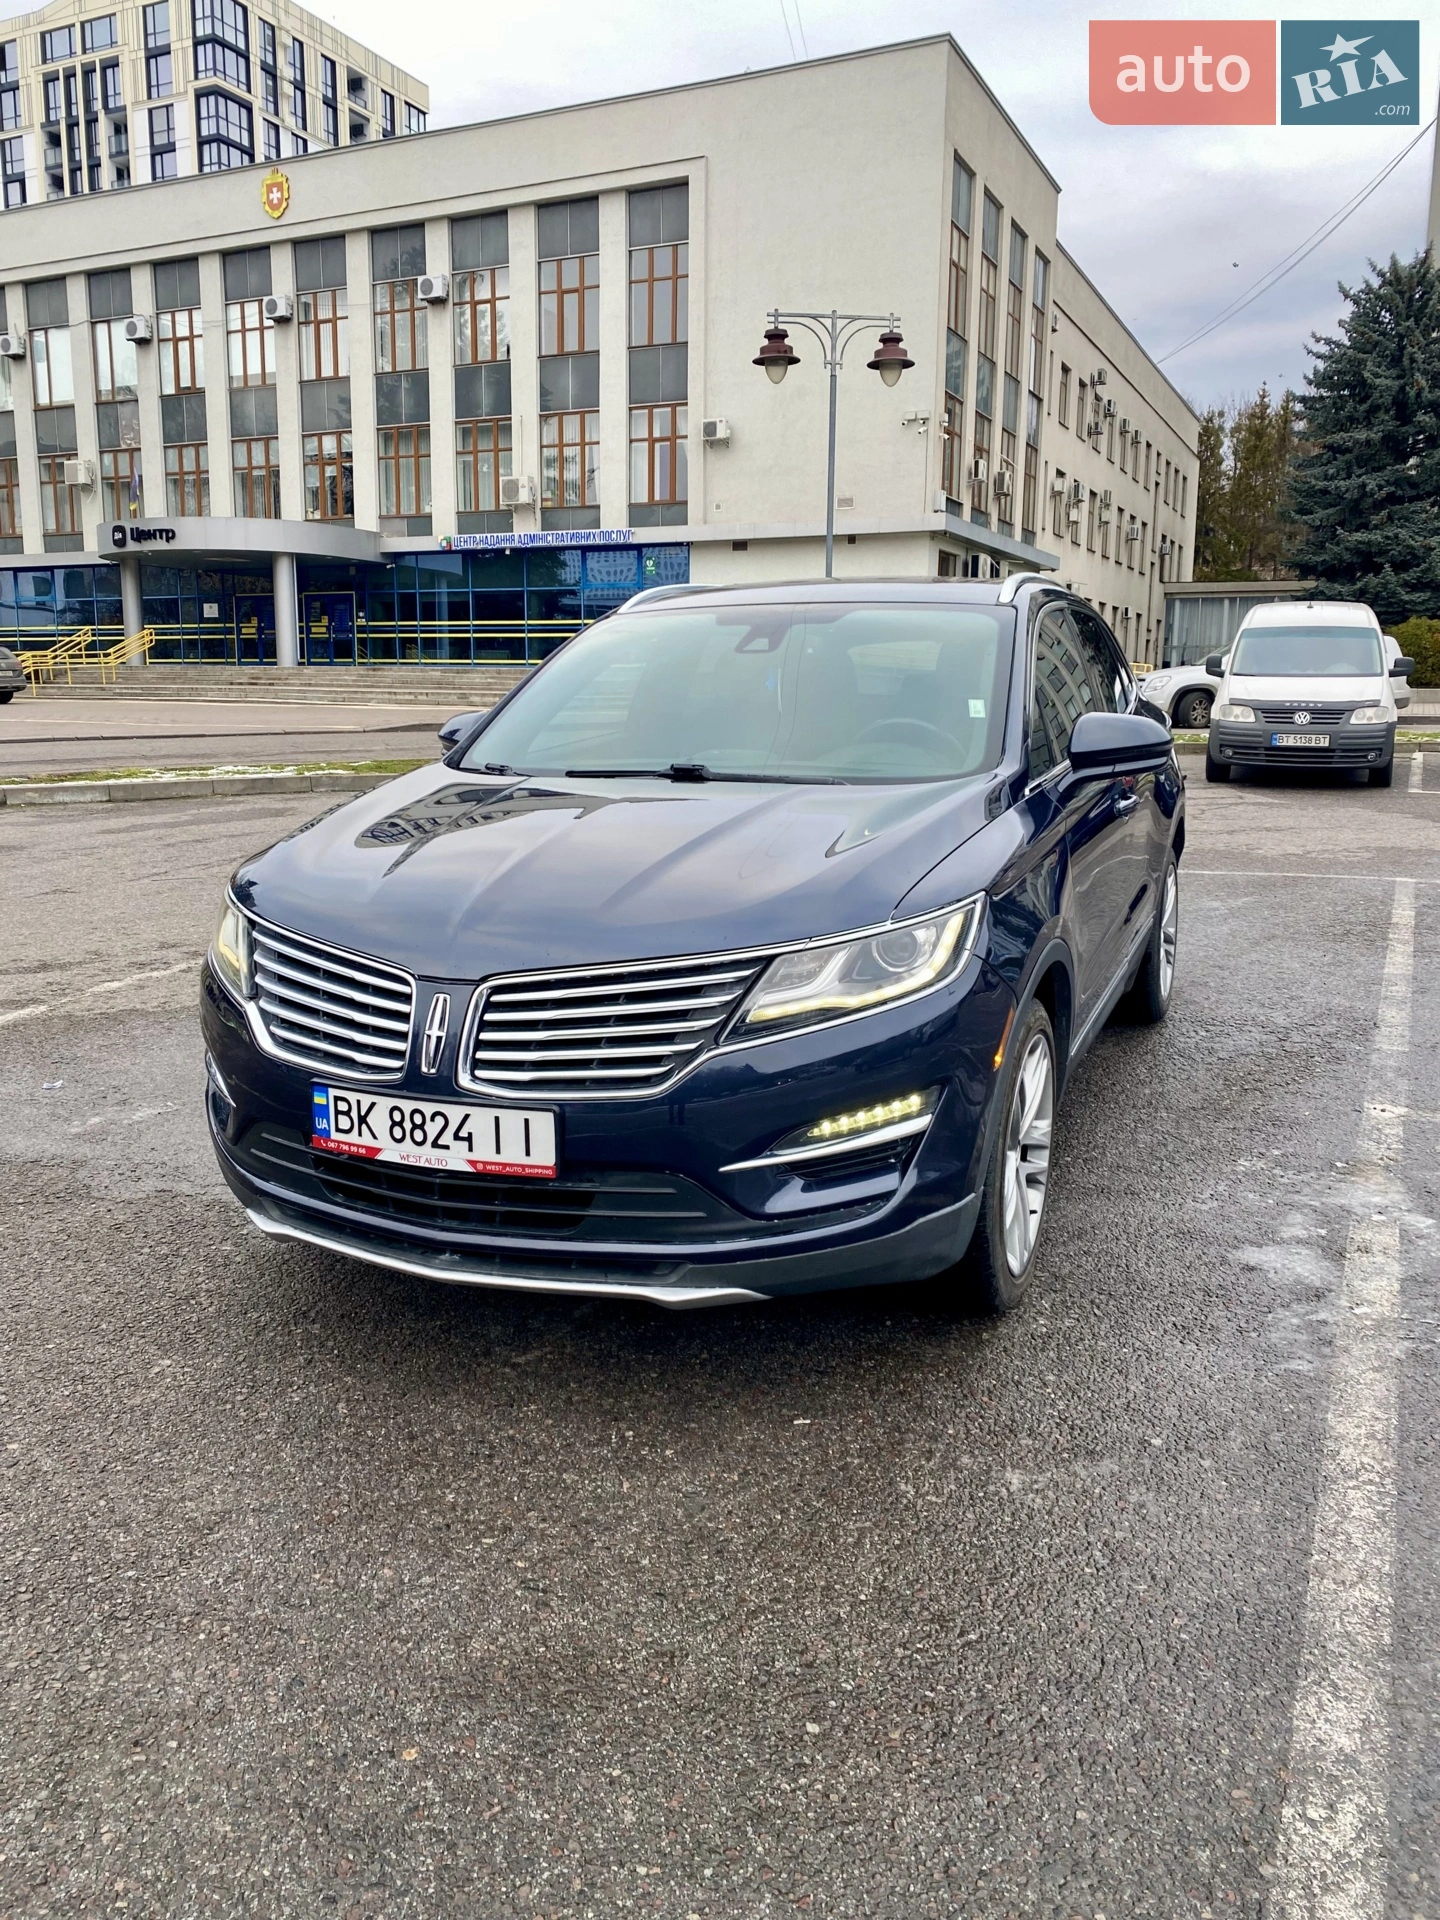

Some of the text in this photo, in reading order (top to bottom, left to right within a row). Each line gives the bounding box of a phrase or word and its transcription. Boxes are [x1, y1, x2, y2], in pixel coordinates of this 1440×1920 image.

[130, 526, 176, 544] Центр
[453, 529, 634, 549] ЦЕНТР НАДАННЯ АДМІНІСТРАТИВНИХ ПОСЛУГ
[1278, 735, 1328, 745] BT 5138 BT
[315, 1117, 329, 1130] UA
[333, 1095, 378, 1140] BK
[389, 1105, 473, 1153] 8824
[399, 1153, 448, 1168] WEST AUTO
[485, 1164, 553, 1176] WEST_AUTO_SHIPPING
